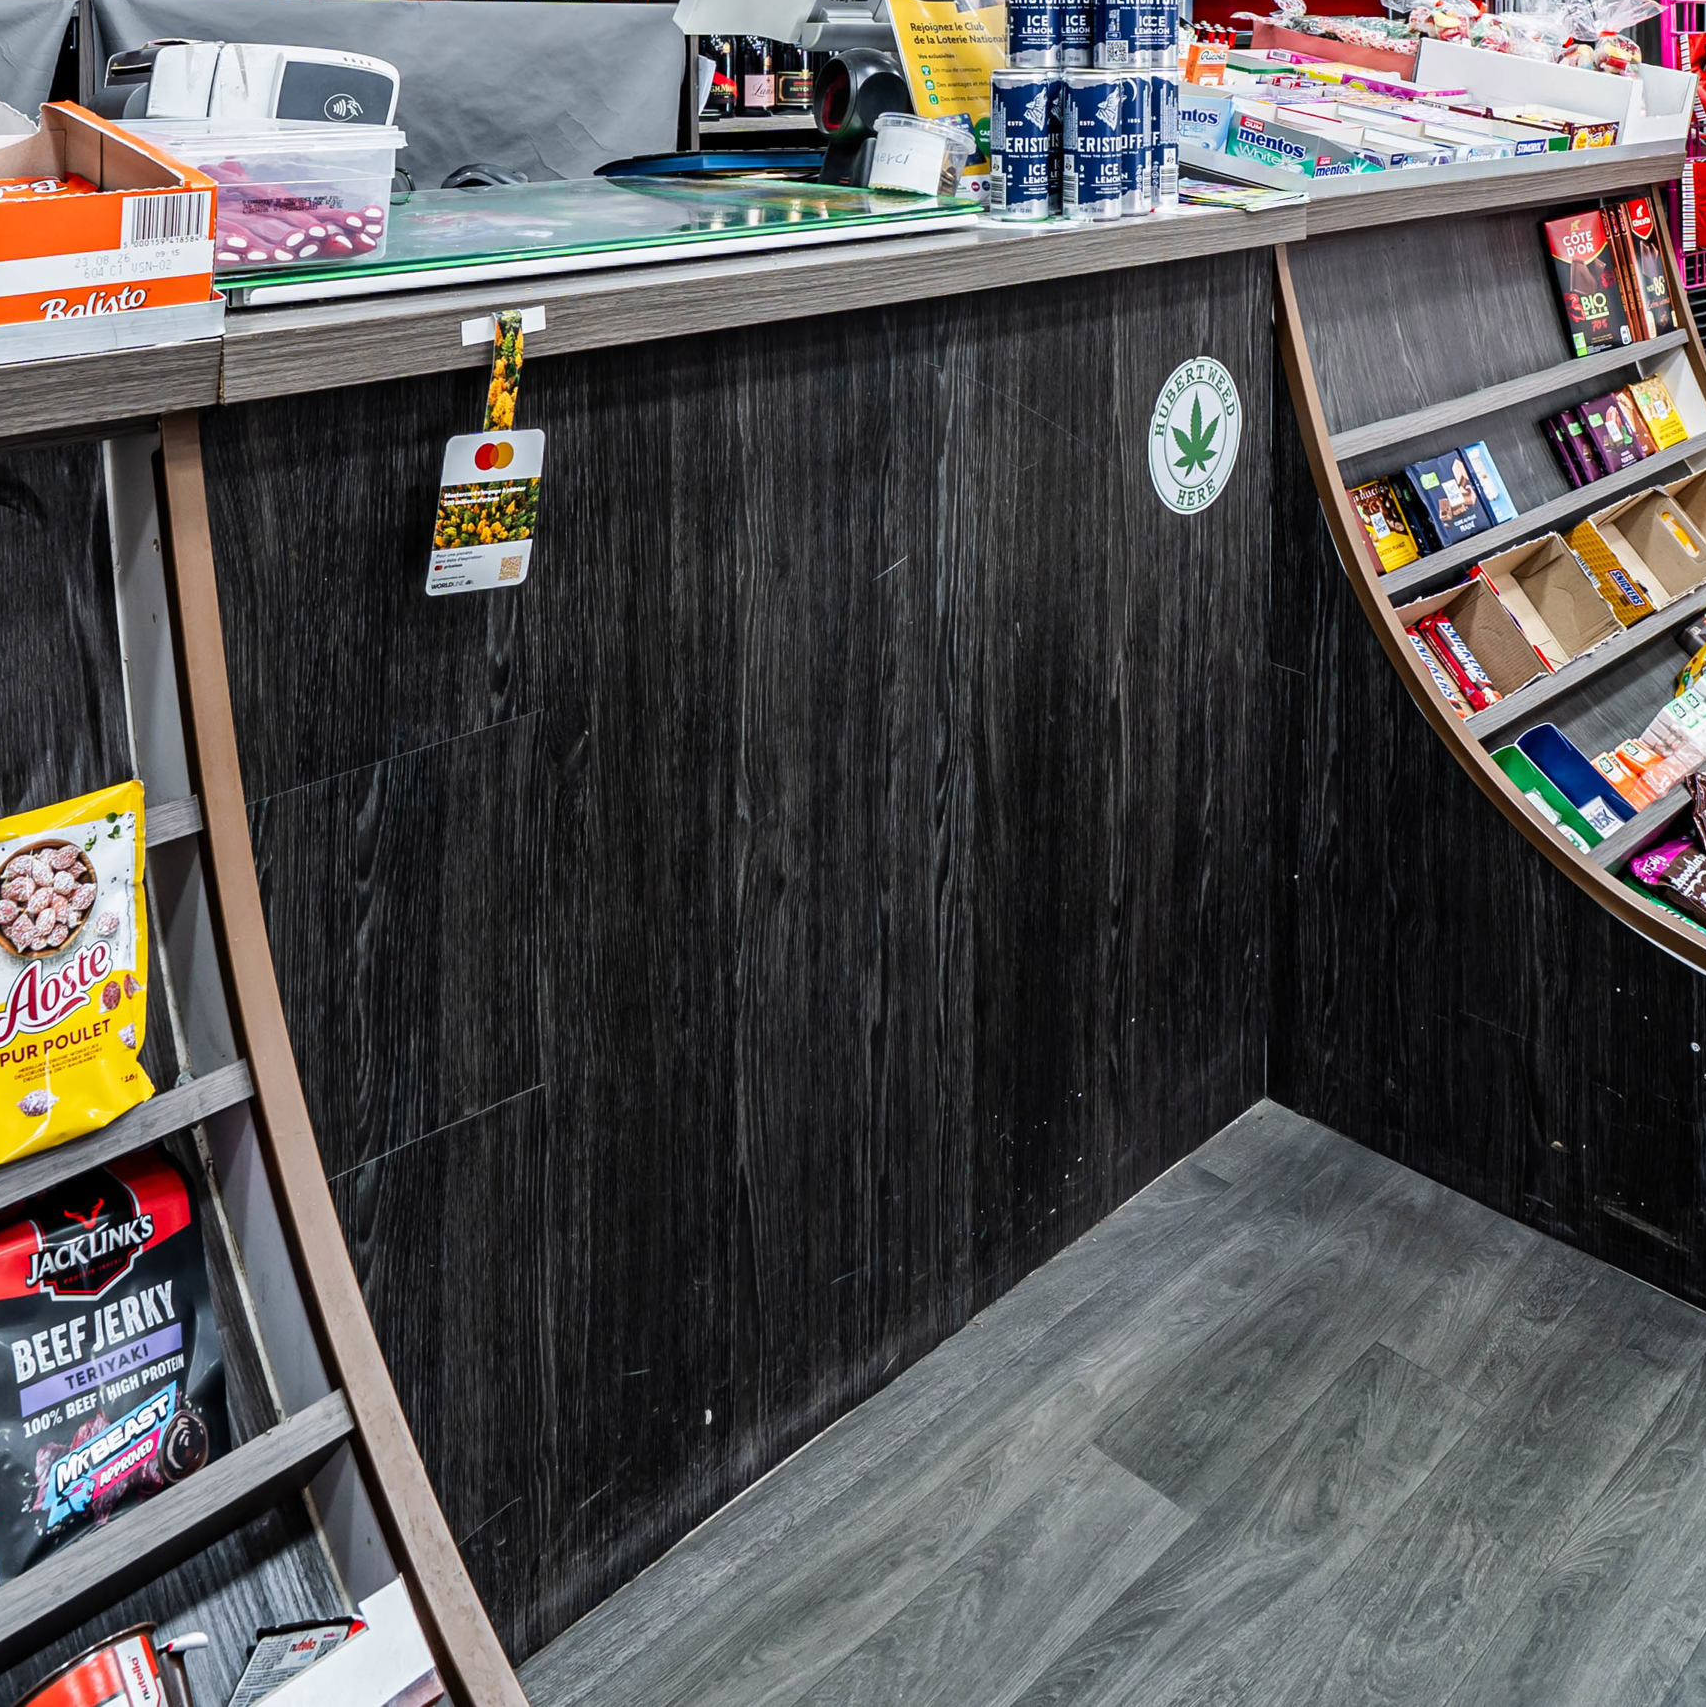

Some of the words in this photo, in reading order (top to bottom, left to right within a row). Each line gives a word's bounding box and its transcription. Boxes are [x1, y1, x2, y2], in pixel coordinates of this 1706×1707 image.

[910, 22, 953, 33] Rejoignez
[954, 22, 963, 31] le
[964, 22, 985, 32] Club
[1021, 26, 1054, 35] LEMON
[1026, 15, 1049, 27] ICE
[1061, 26, 1091, 34] LEMON
[1065, 15, 1087, 27] ICE
[914, 35, 925, 45] de
[927, 35, 935, 45] la
[936, 34, 967, 45] Loterie
[1200, 50, 1227, 66] Ricola
[1243, 121, 1264, 132] GUM
[1237, 142, 1282, 166] White
[1238, 127, 1307, 161] mentos
[1028, 163, 1047, 176] ICE
[1100, 163, 1119, 176] ICE
[1315, 163, 1351, 178] mentos
[1562, 229, 1594, 248] CÔTE
[1566, 240, 1595, 257] D'OR
[39, 285, 148, 321] Balisto
[1581, 292, 1607, 313] BIO
[1154, 364, 1205, 437] HUBERT
[1207, 366, 1236, 417] WEED
[1176, 478, 1216, 507] HERE
[1609, 569, 1645, 606] SNICKERS
[1441, 621, 1491, 689] SNICKERS
[1410, 635, 1456, 701] SNICKERS
[0, 1044, 38, 1067] PUR
[43, 1018, 111, 1055] POULET
[26, 1239, 90, 1292] JACK
[88, 1215, 155, 1261] LINK'S
[10, 1321, 87, 1386] BEEF
[91, 1280, 179, 1354] JERKY
[64, 1344, 151, 1392] TERIYAKI
[22, 1411, 65, 1439] 100%
[66, 1395, 99, 1423] BEEF
[106, 1377, 138, 1406] HIGH
[138, 1354, 187, 1394] PROTEIN
[96, 1438, 158, 1487] APPROVED
